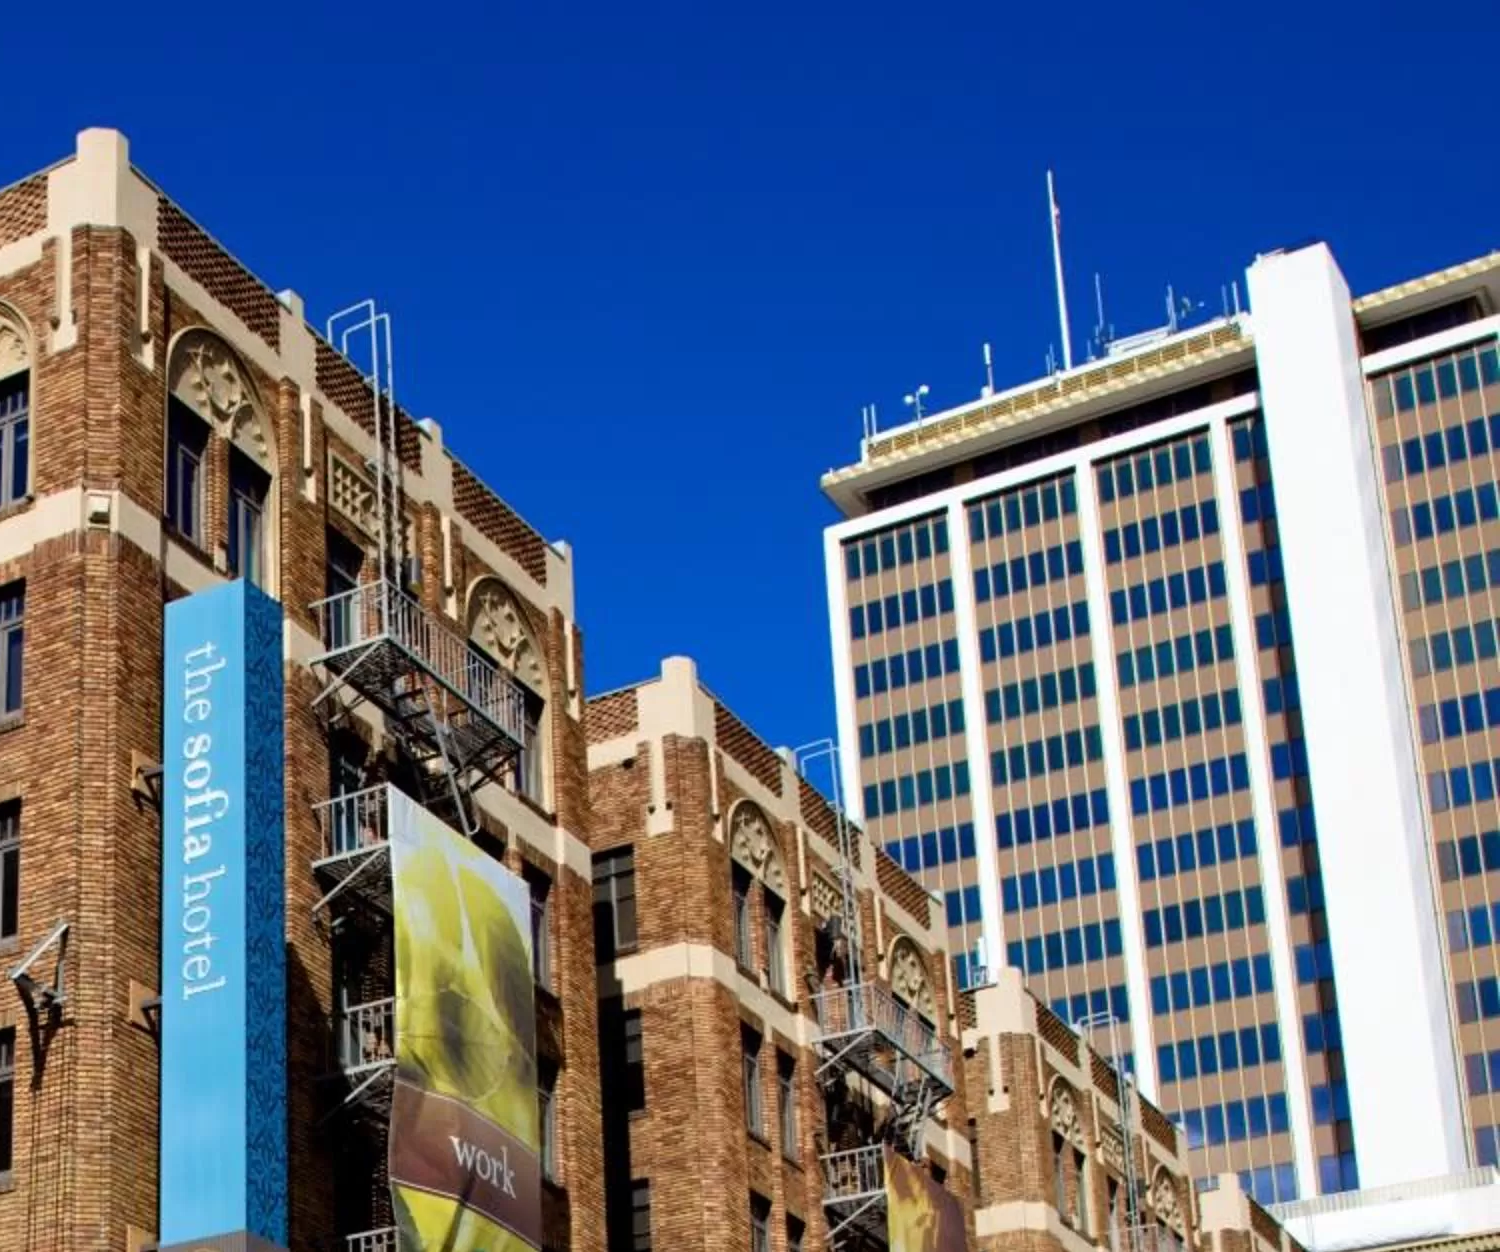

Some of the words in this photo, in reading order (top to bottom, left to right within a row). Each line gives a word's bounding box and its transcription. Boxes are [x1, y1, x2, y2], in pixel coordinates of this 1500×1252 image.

[183, 641, 227, 724] the
[182, 732, 229, 864] sofia
[182, 864, 227, 1001] hotel
[447, 1134, 517, 1200] work
